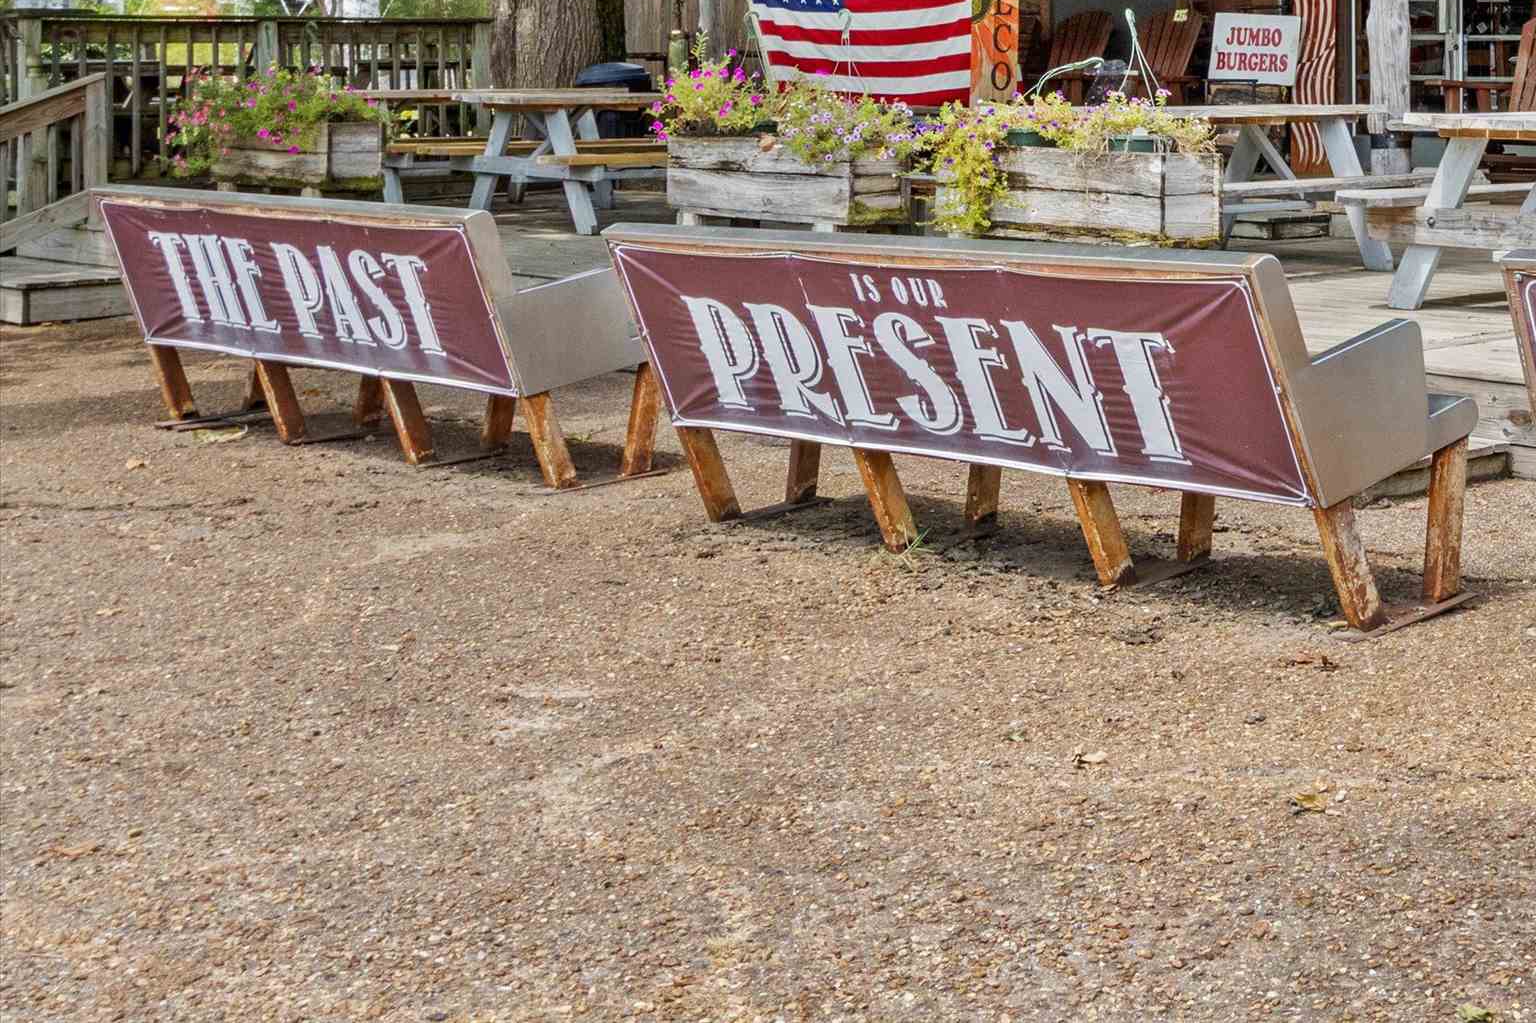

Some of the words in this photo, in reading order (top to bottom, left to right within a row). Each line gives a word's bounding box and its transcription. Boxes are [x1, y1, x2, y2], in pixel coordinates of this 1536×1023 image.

[1226, 26, 1282, 47] JUMBO
[1215, 52, 1288, 73] BURGERS
[148, 230, 281, 334] THE
[270, 241, 447, 358] PAST
[848, 272, 881, 304] IS
[891, 276, 947, 309] OUR
[678, 294, 1192, 466] PRESENT
